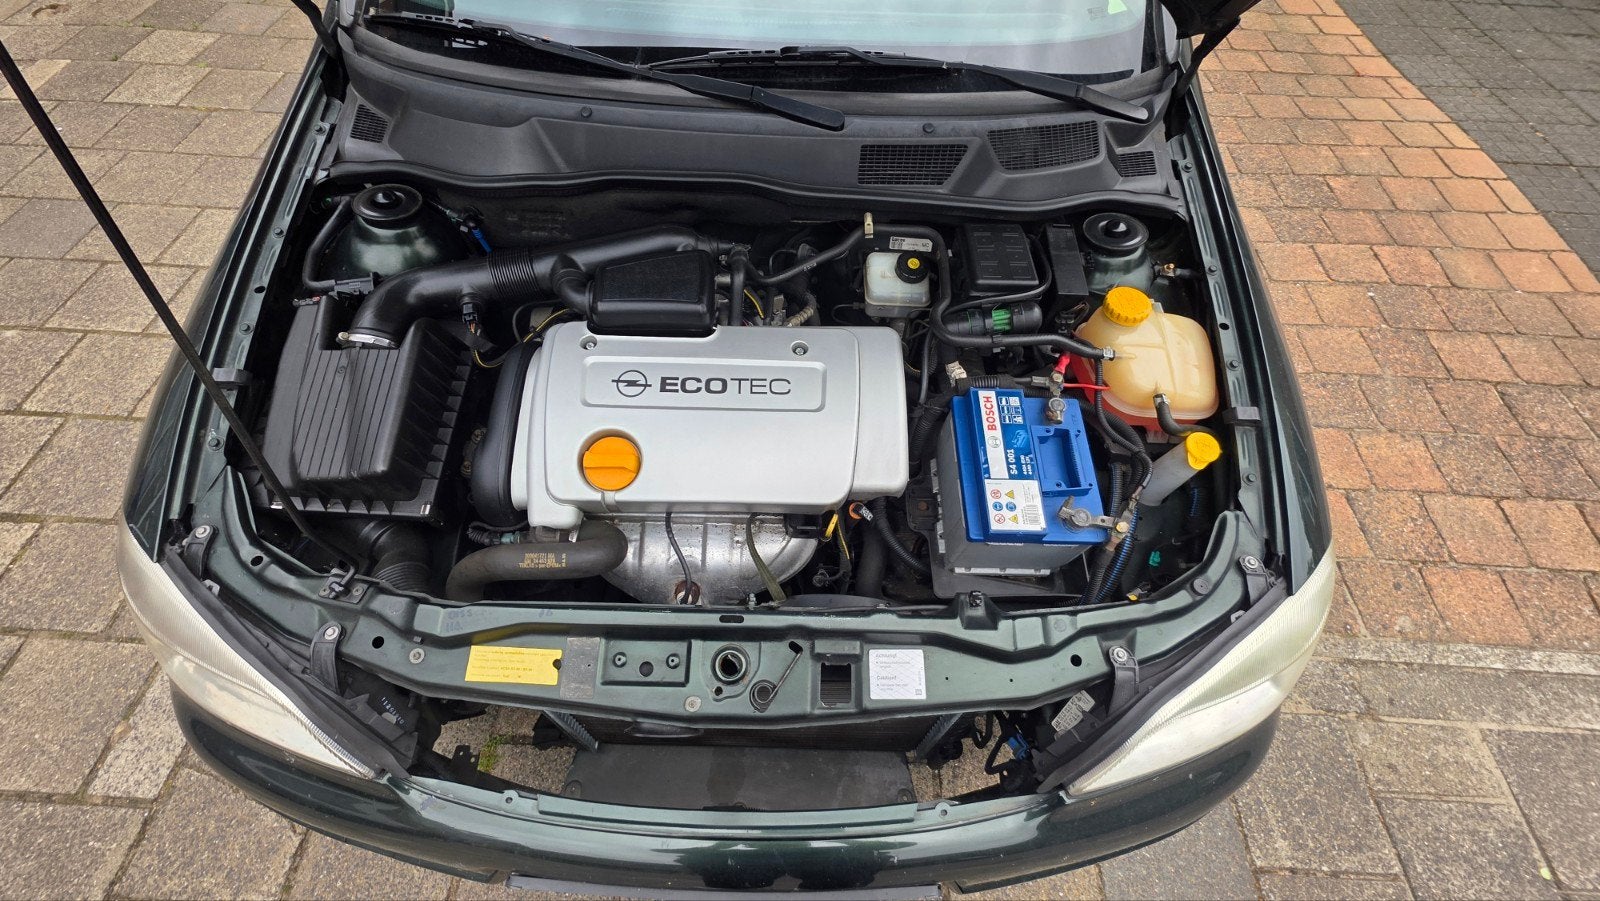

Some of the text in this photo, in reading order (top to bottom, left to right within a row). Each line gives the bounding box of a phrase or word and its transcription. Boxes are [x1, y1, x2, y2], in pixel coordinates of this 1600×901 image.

[659, 376, 791, 395] ECOTEC
[983, 396, 997, 431] BOSCH
[1007, 448, 1018, 475] S4 001
